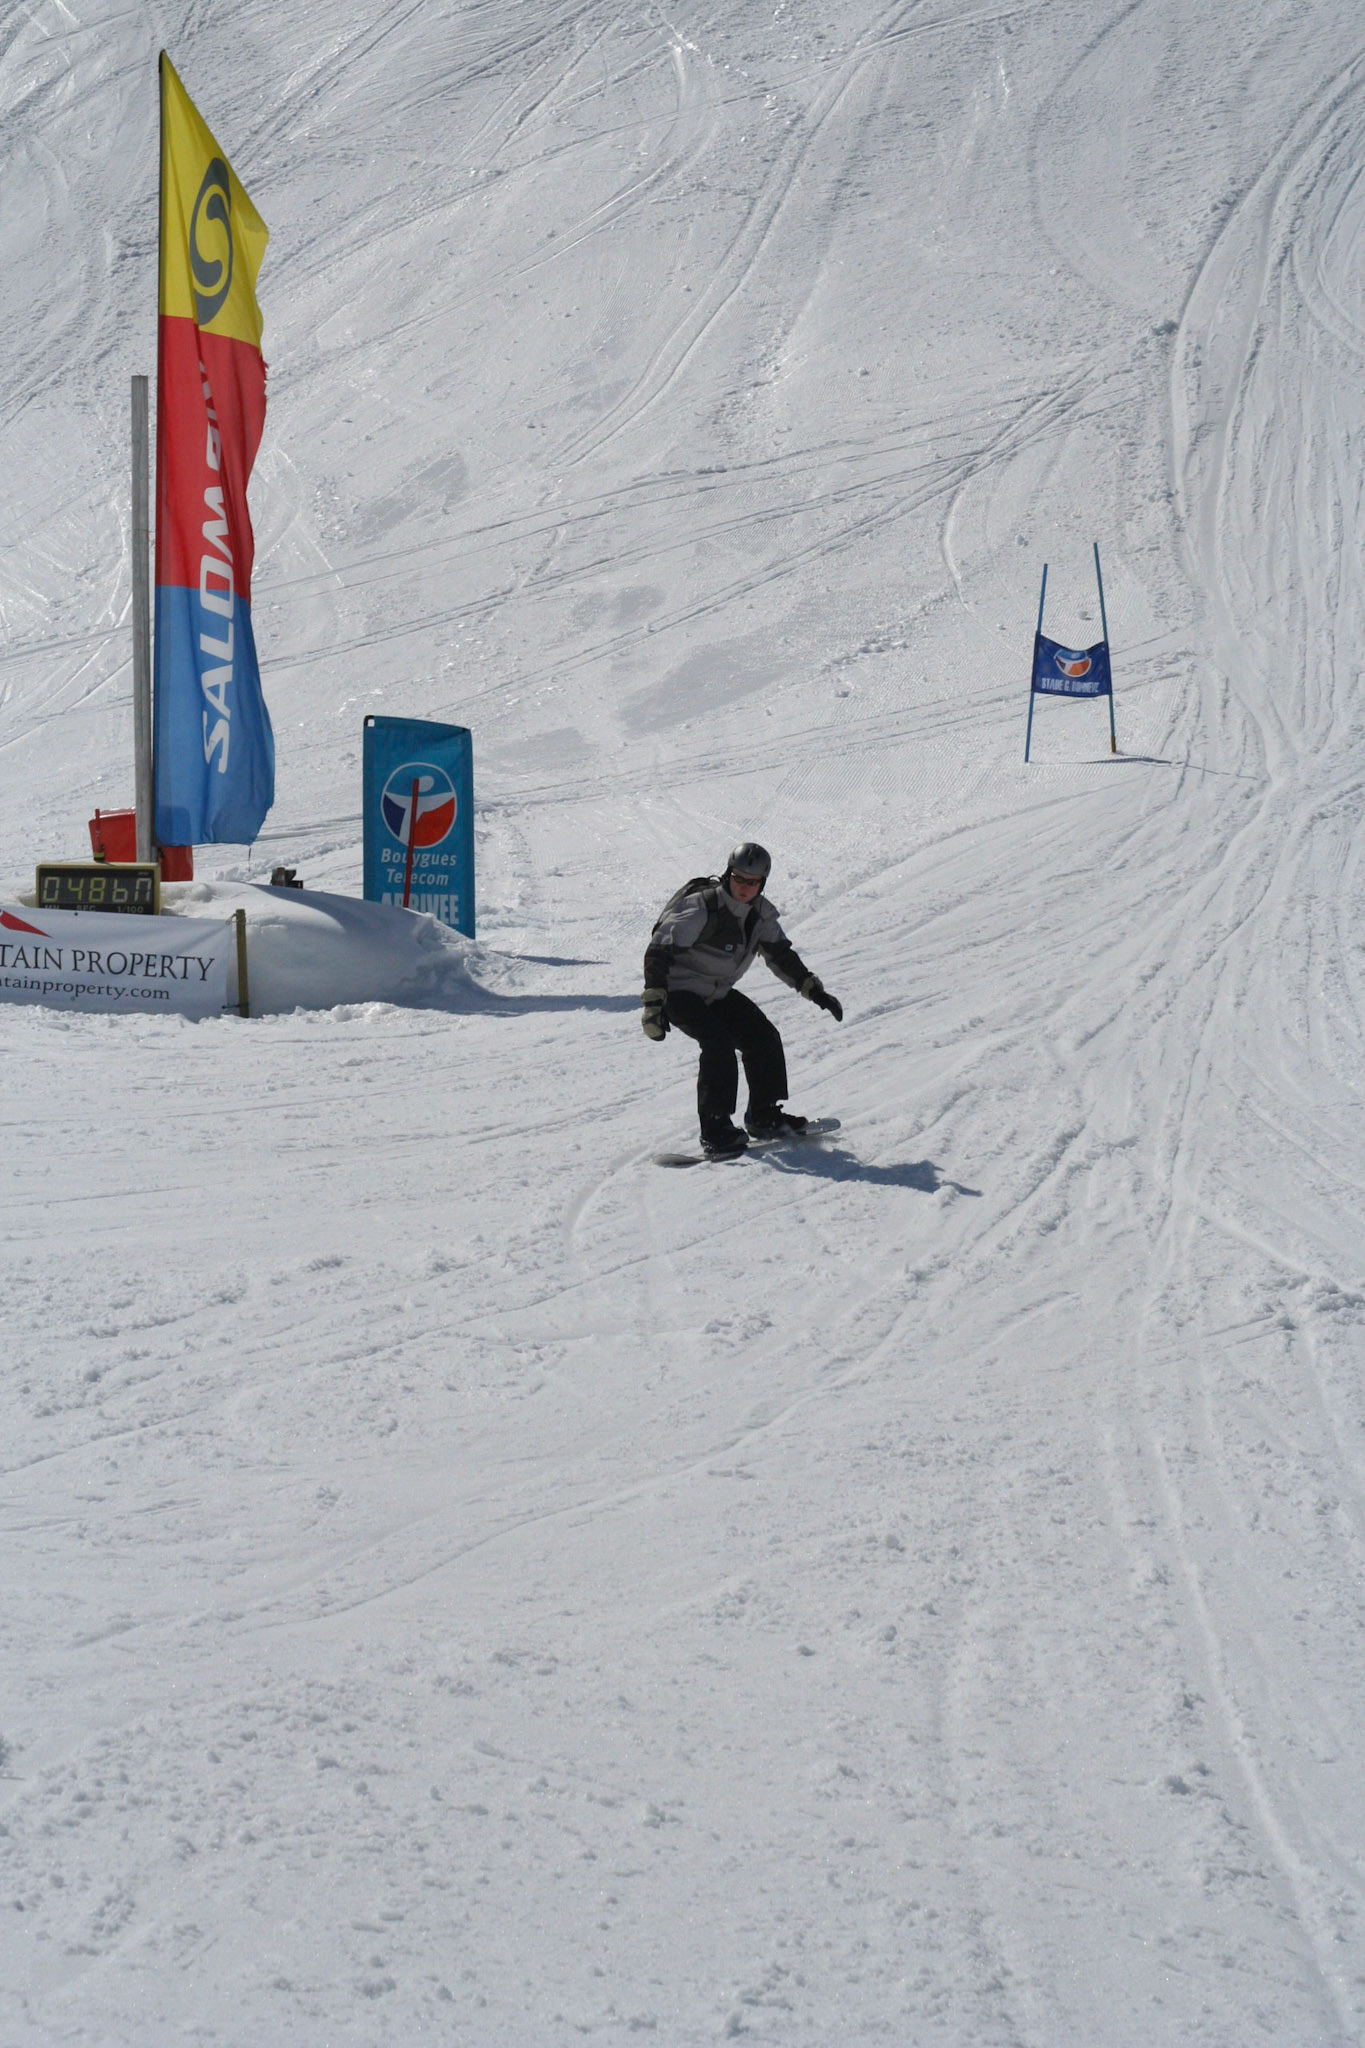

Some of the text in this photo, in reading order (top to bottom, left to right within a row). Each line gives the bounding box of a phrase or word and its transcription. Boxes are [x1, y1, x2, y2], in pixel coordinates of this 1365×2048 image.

[199, 360, 235, 774] SALOMO
[381, 848, 457, 868] Bouygues
[387, 868, 449, 886] Teecom
[117, 906, 144, 914] 1/100
[0, 944, 215, 982] TAIN PROPERTY
[0, 975, 170, 1001] tainproperty.com
